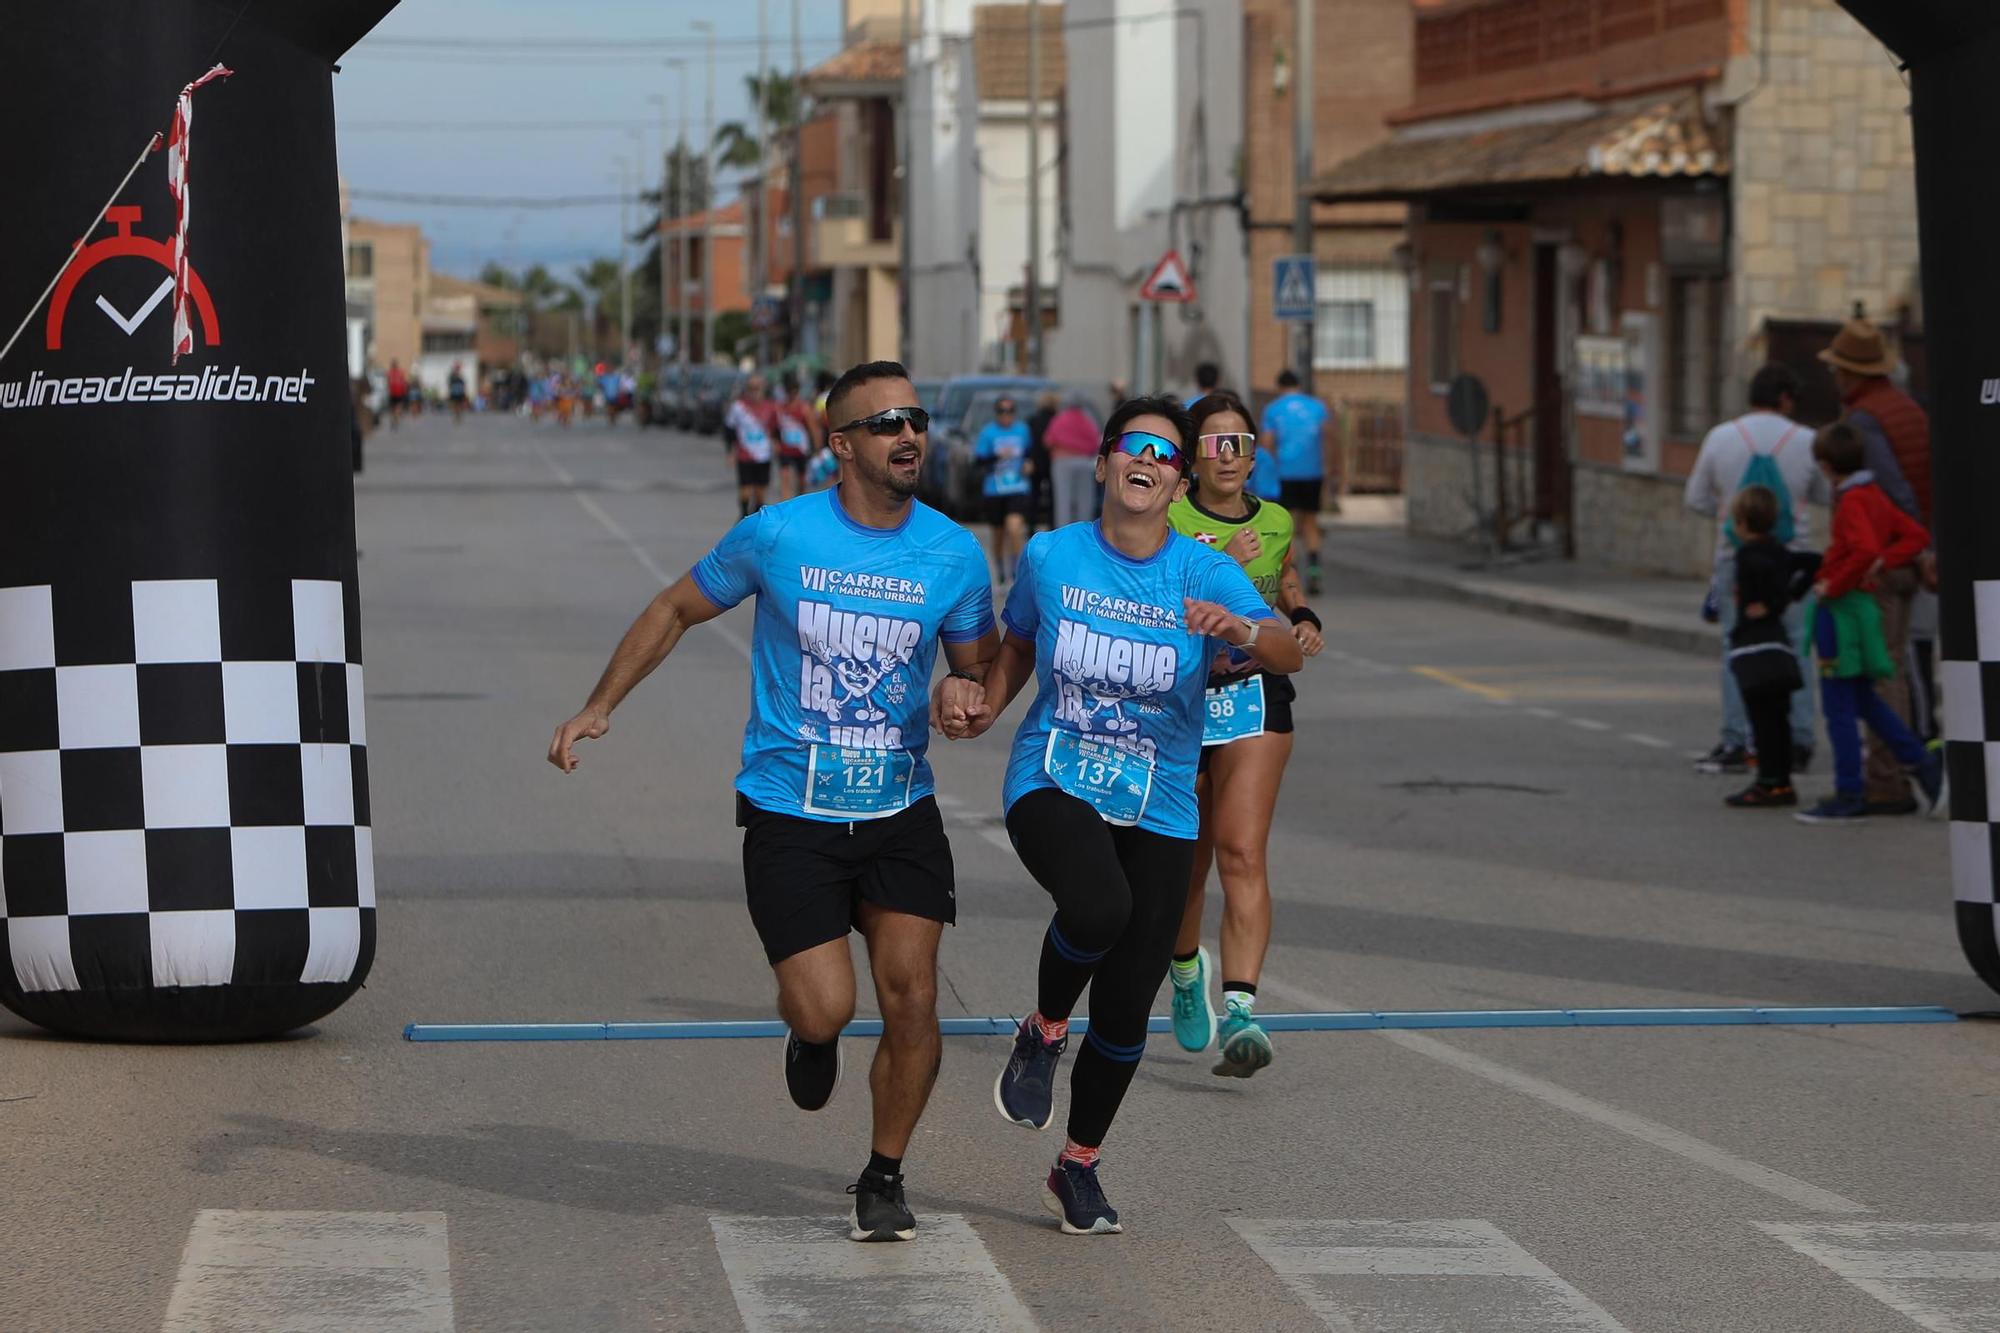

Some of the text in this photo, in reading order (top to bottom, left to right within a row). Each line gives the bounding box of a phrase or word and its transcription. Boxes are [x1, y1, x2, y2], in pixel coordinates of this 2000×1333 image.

[0, 365, 315, 408] w.lineadesalida.net
[800, 566, 925, 595] VII CARRERA
[828, 584, 925, 605] Y MARCHA URBANA
[1062, 585, 1177, 621] VII CARRERA
[1086, 605, 1177, 630] Y MARCHA URBANA
[798, 600, 921, 664] Mueve
[1053, 619, 1176, 692] Mueve
[800, 654, 832, 713] la
[1053, 673, 1084, 723] la
[1209, 699, 1235, 719] 98
[843, 766, 885, 787] 121
[1077, 759, 1122, 788] 137
